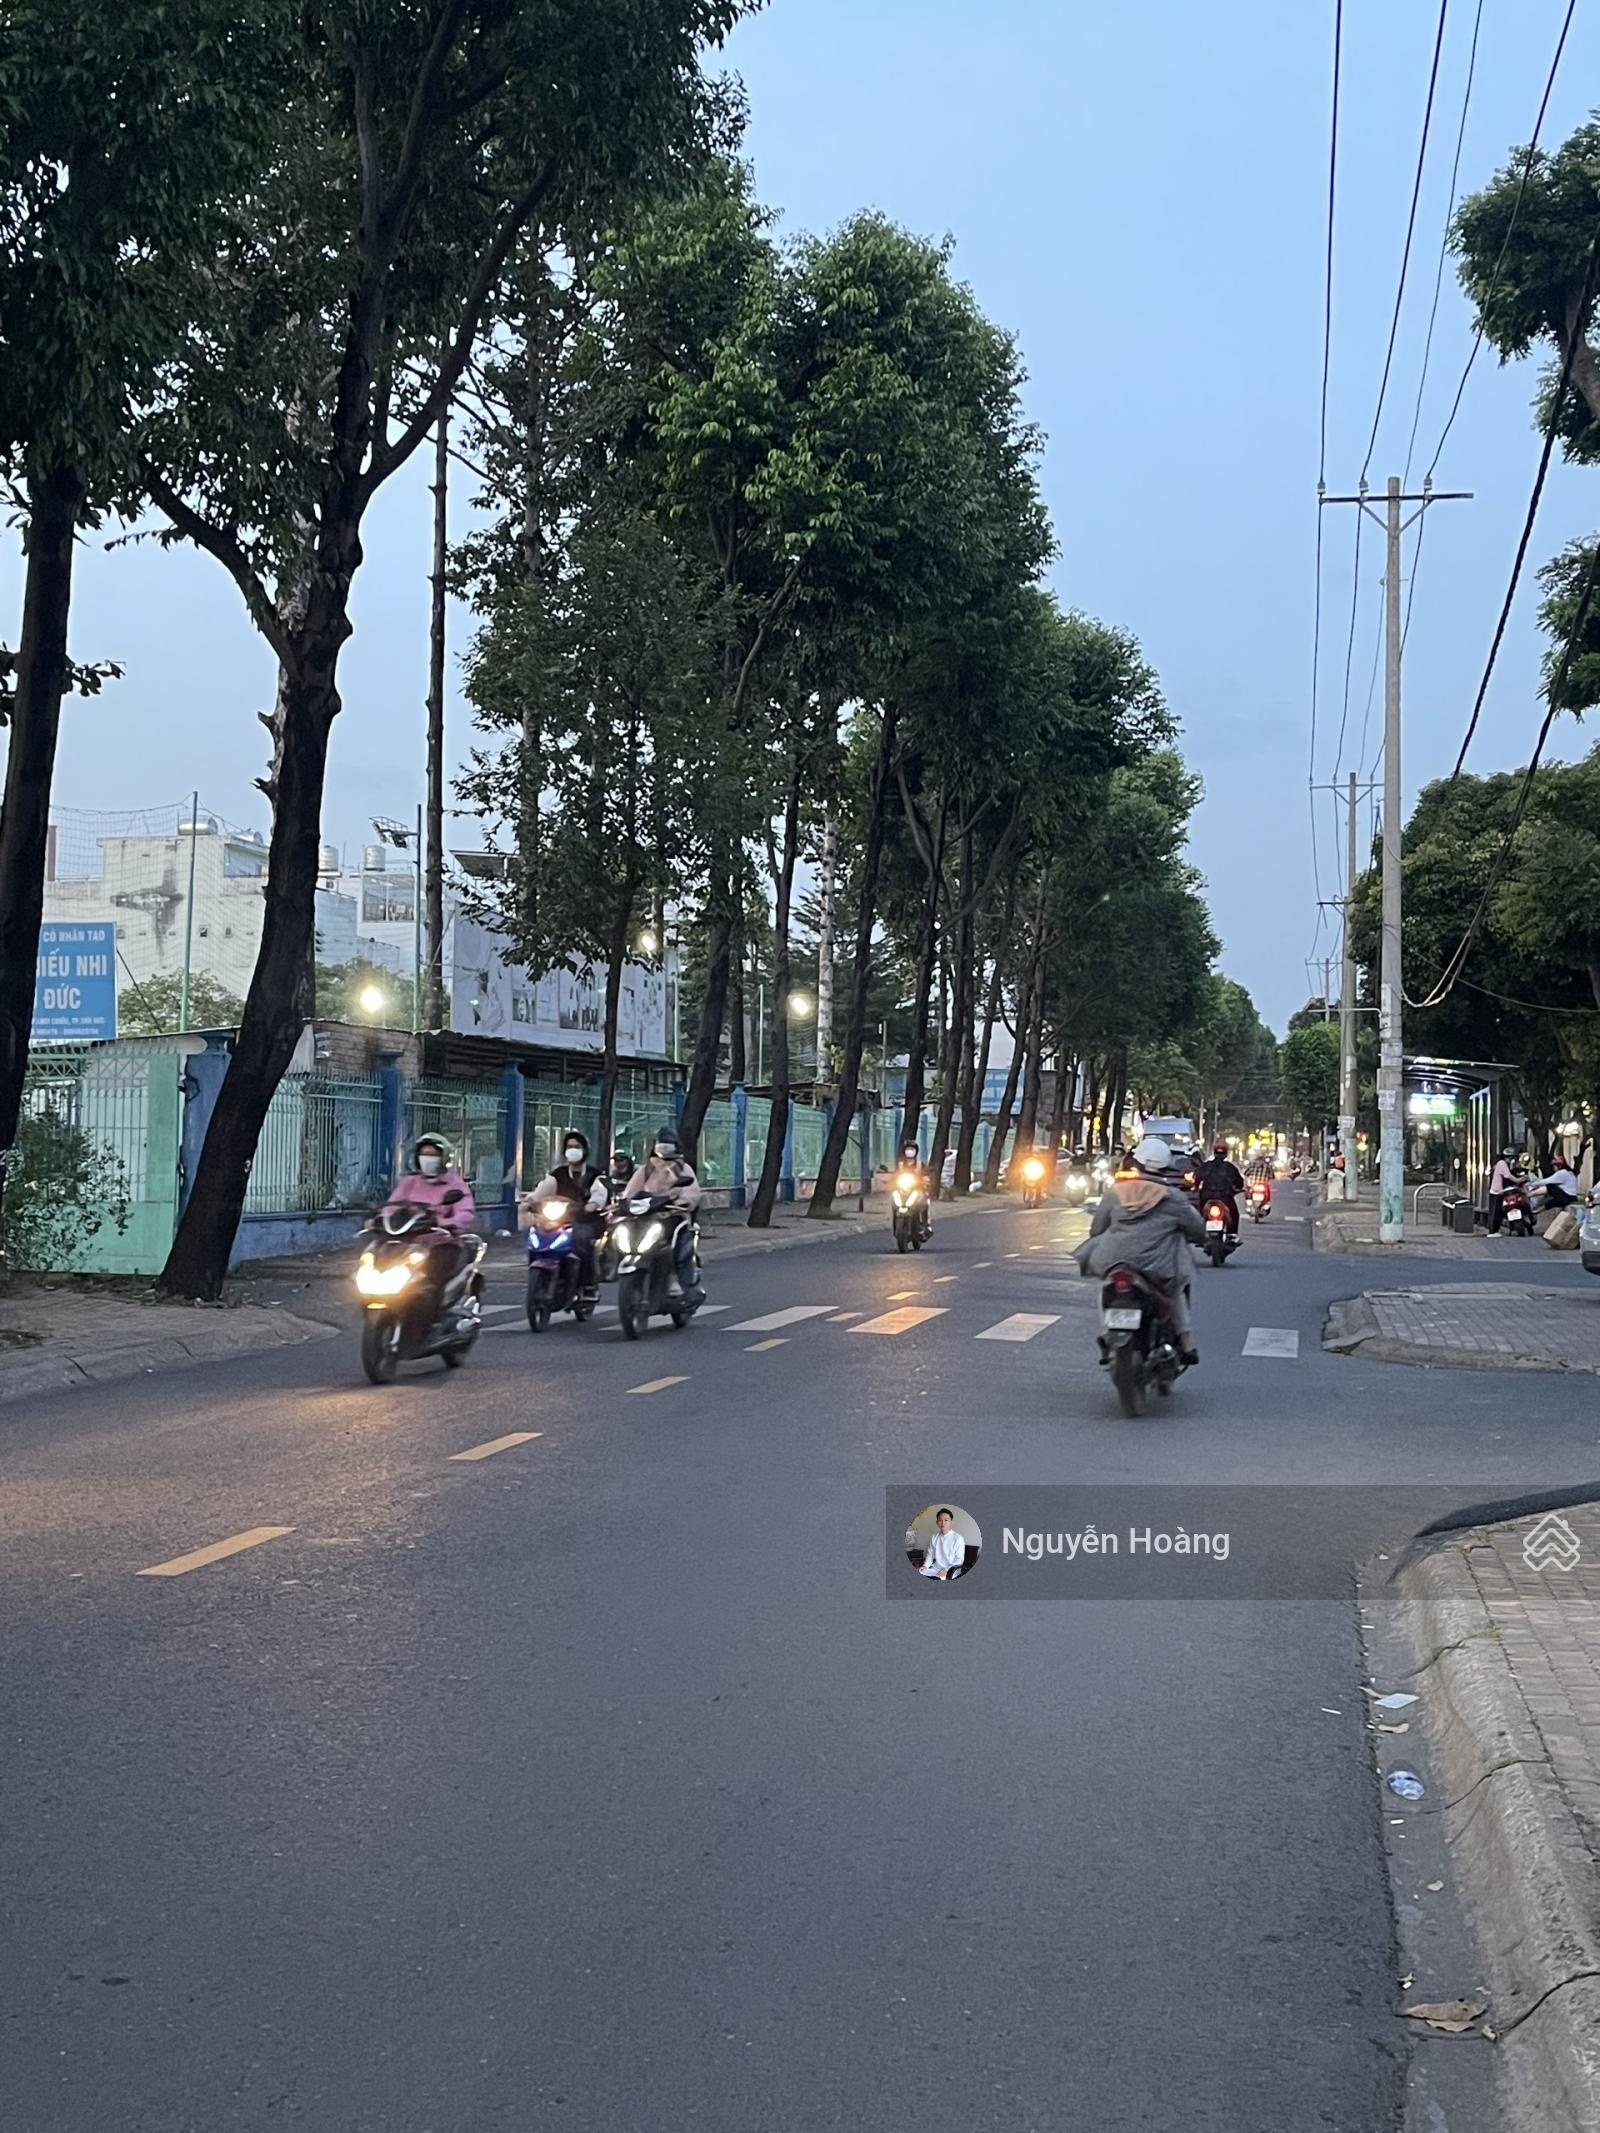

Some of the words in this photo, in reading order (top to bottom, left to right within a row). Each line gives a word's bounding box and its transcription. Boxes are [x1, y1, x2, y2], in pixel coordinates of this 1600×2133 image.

[37, 947, 70, 977] IẾU
[76, 954, 107, 976] NHI
[43, 982, 81, 1009] ĐỨC
